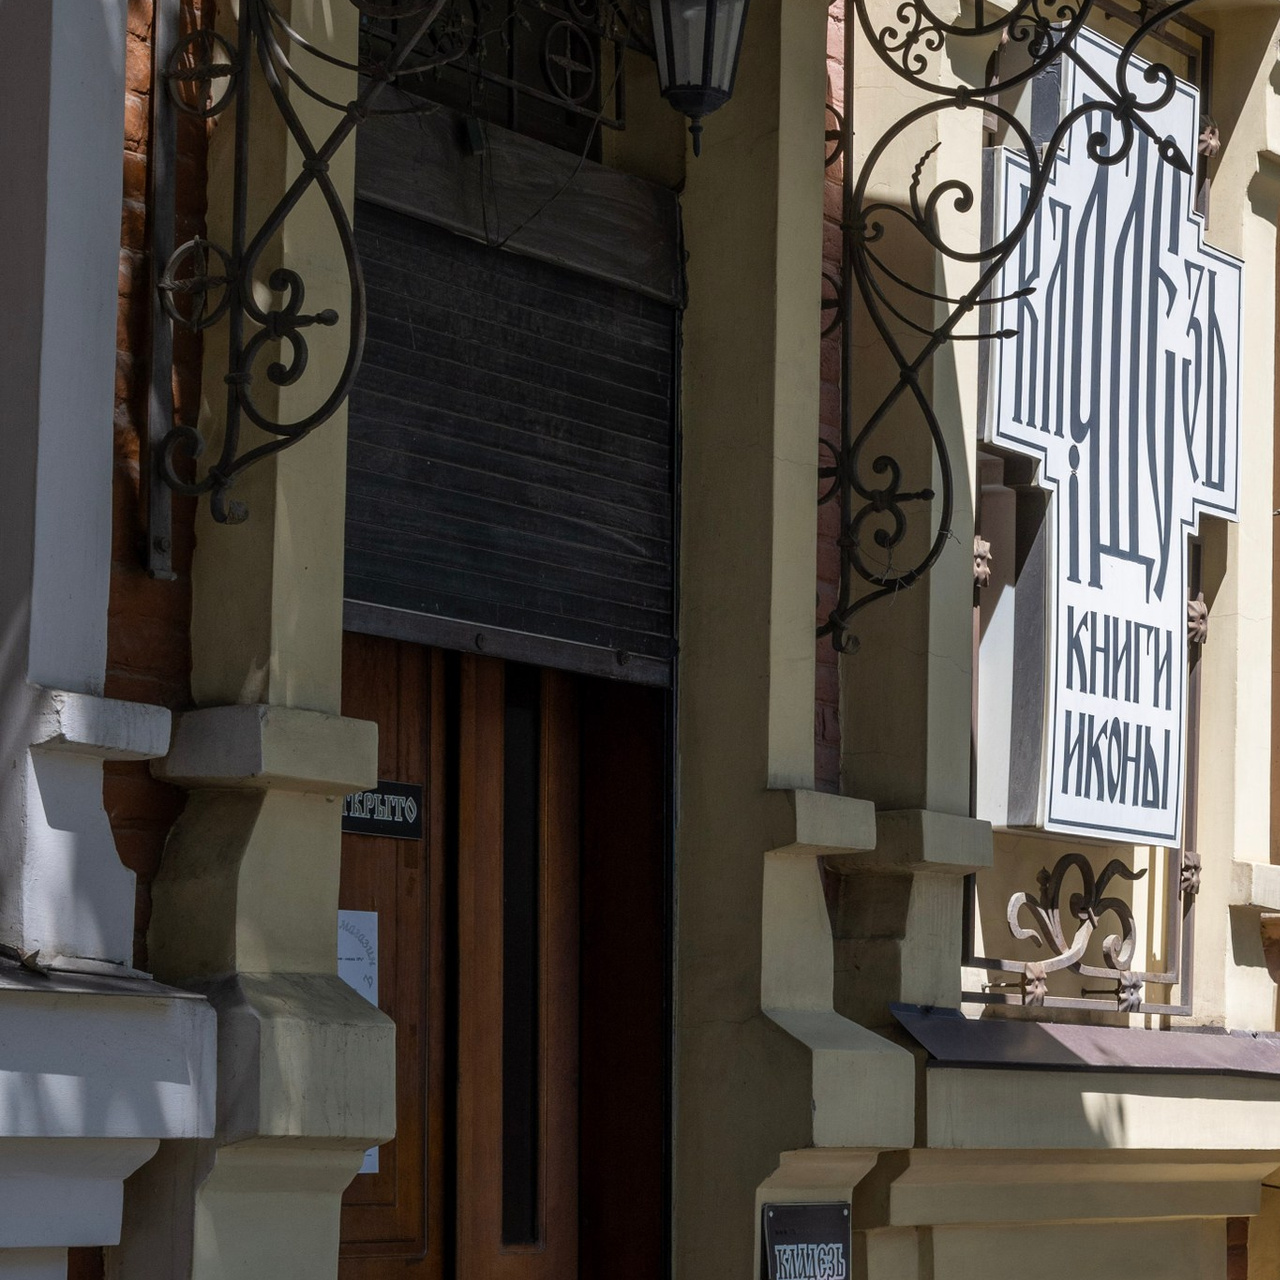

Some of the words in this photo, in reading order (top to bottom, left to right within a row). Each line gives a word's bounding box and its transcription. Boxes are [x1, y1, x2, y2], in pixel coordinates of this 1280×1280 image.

[1066, 605, 1172, 710] КНИГИ
[342, 792, 418, 824] ТКРЫТО
[1061, 709, 1171, 810] ИКОНЫ
